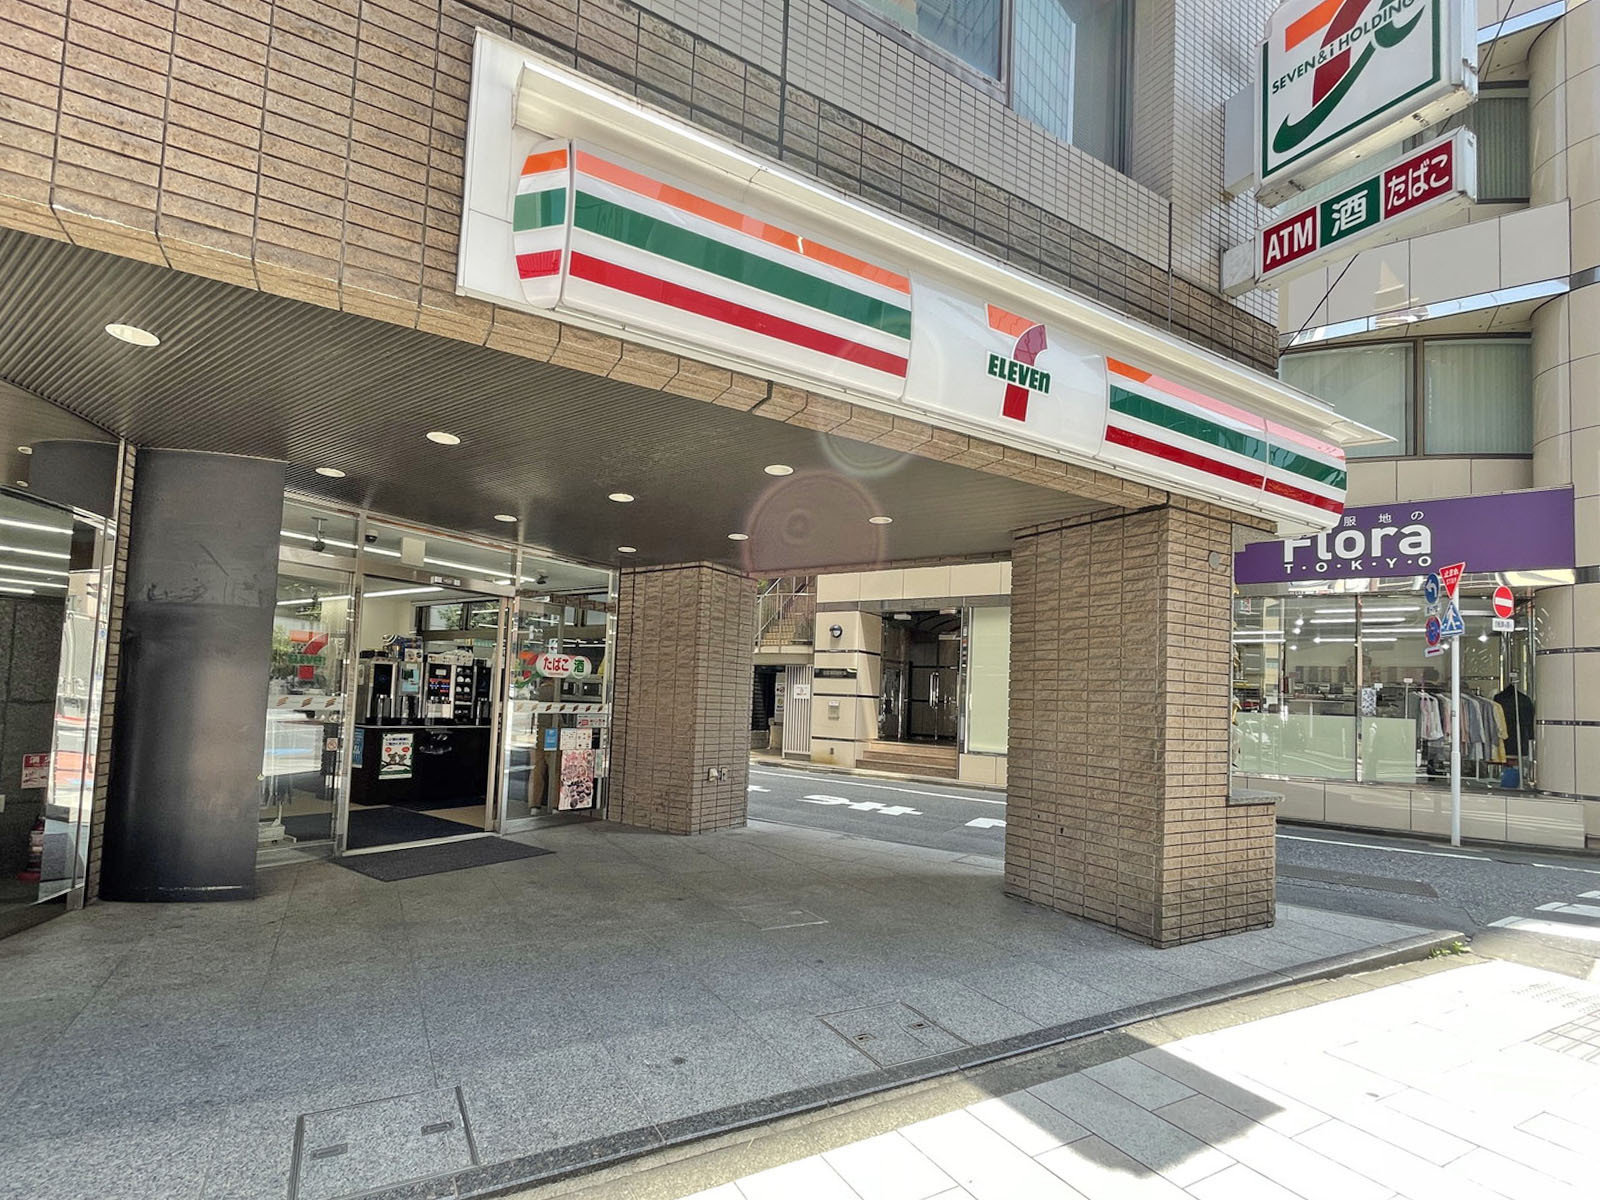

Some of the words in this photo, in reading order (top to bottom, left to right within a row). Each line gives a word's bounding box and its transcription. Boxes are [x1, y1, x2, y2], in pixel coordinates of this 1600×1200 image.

[1266, 216, 1313, 265] ATM
[1331, 189, 1368, 236] 酒
[1387, 154, 1449, 210] たばこ
[543, 656, 570, 671] たばこ
[573, 658, 585, 673] 酒
